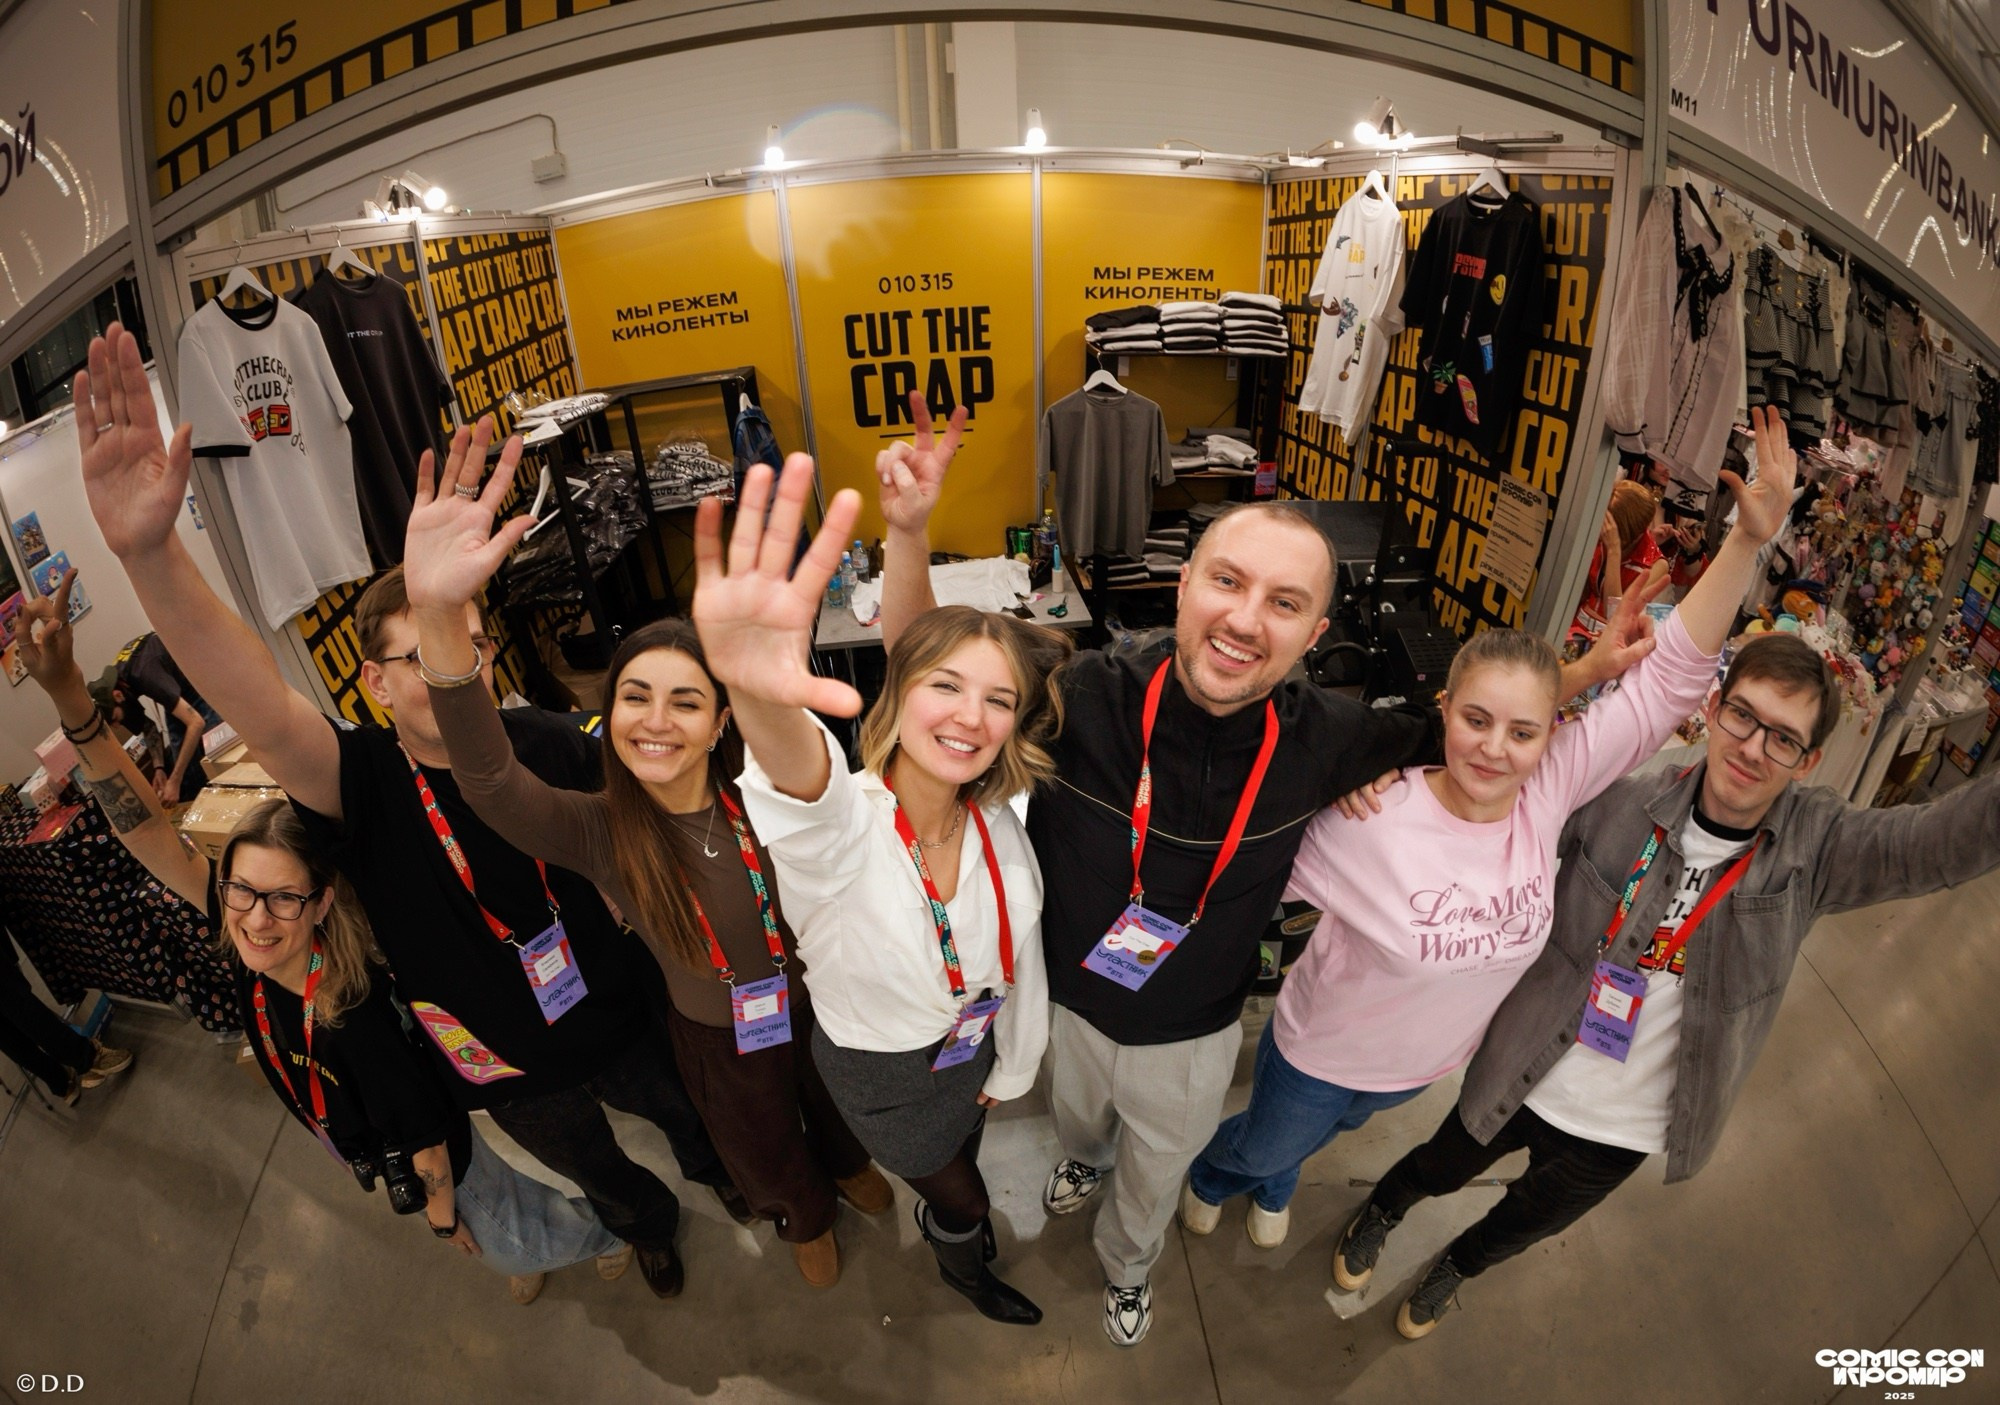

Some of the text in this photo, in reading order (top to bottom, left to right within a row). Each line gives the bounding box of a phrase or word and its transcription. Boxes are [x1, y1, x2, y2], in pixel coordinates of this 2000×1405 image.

[168, 19, 298, 129] 010 315
[1671, 88, 1698, 117] M11
[1706, 0, 2000, 268] URMURIN/BANK
[1267, 224, 1288, 255] CUT
[1289, 220, 1312, 254] THE
[428, 266, 466, 312] THE
[463, 258, 496, 300] CUT
[494, 251, 523, 290] THE
[521, 243, 547, 281] CUT
[878, 272, 954, 294] 010 315
[1085, 286, 1221, 300] КИНОЛЕНТЫ
[1093, 267, 1214, 282] МЫ РЕЖЕМ
[473, 289, 533, 357] CRAP
[611, 309, 750, 342] КИНОЛЕНТЫ
[616, 291, 739, 322] МЫ РЕЖЕМ
[844, 305, 992, 359] CUT THE
[247, 380, 283, 401] CLUB
[455, 369, 492, 418] THE
[488, 354, 518, 400] CUT
[515, 342, 545, 383] THE
[541, 332, 566, 370] CUT
[850, 355, 995, 428] CRAP
[1523, 349, 1581, 412] CUT
[1296, 445, 1349, 500] CRAP
[1452, 467, 1499, 530] THE
[1527, 491, 1541, 505] CON
[312, 614, 366, 694] CUT
[1409, 875, 1542, 927] Love More
[1419, 930, 1500, 963] Worry
[1450, 964, 1479, 975] CHASE
[441, 1027, 466, 1043] HOVER
